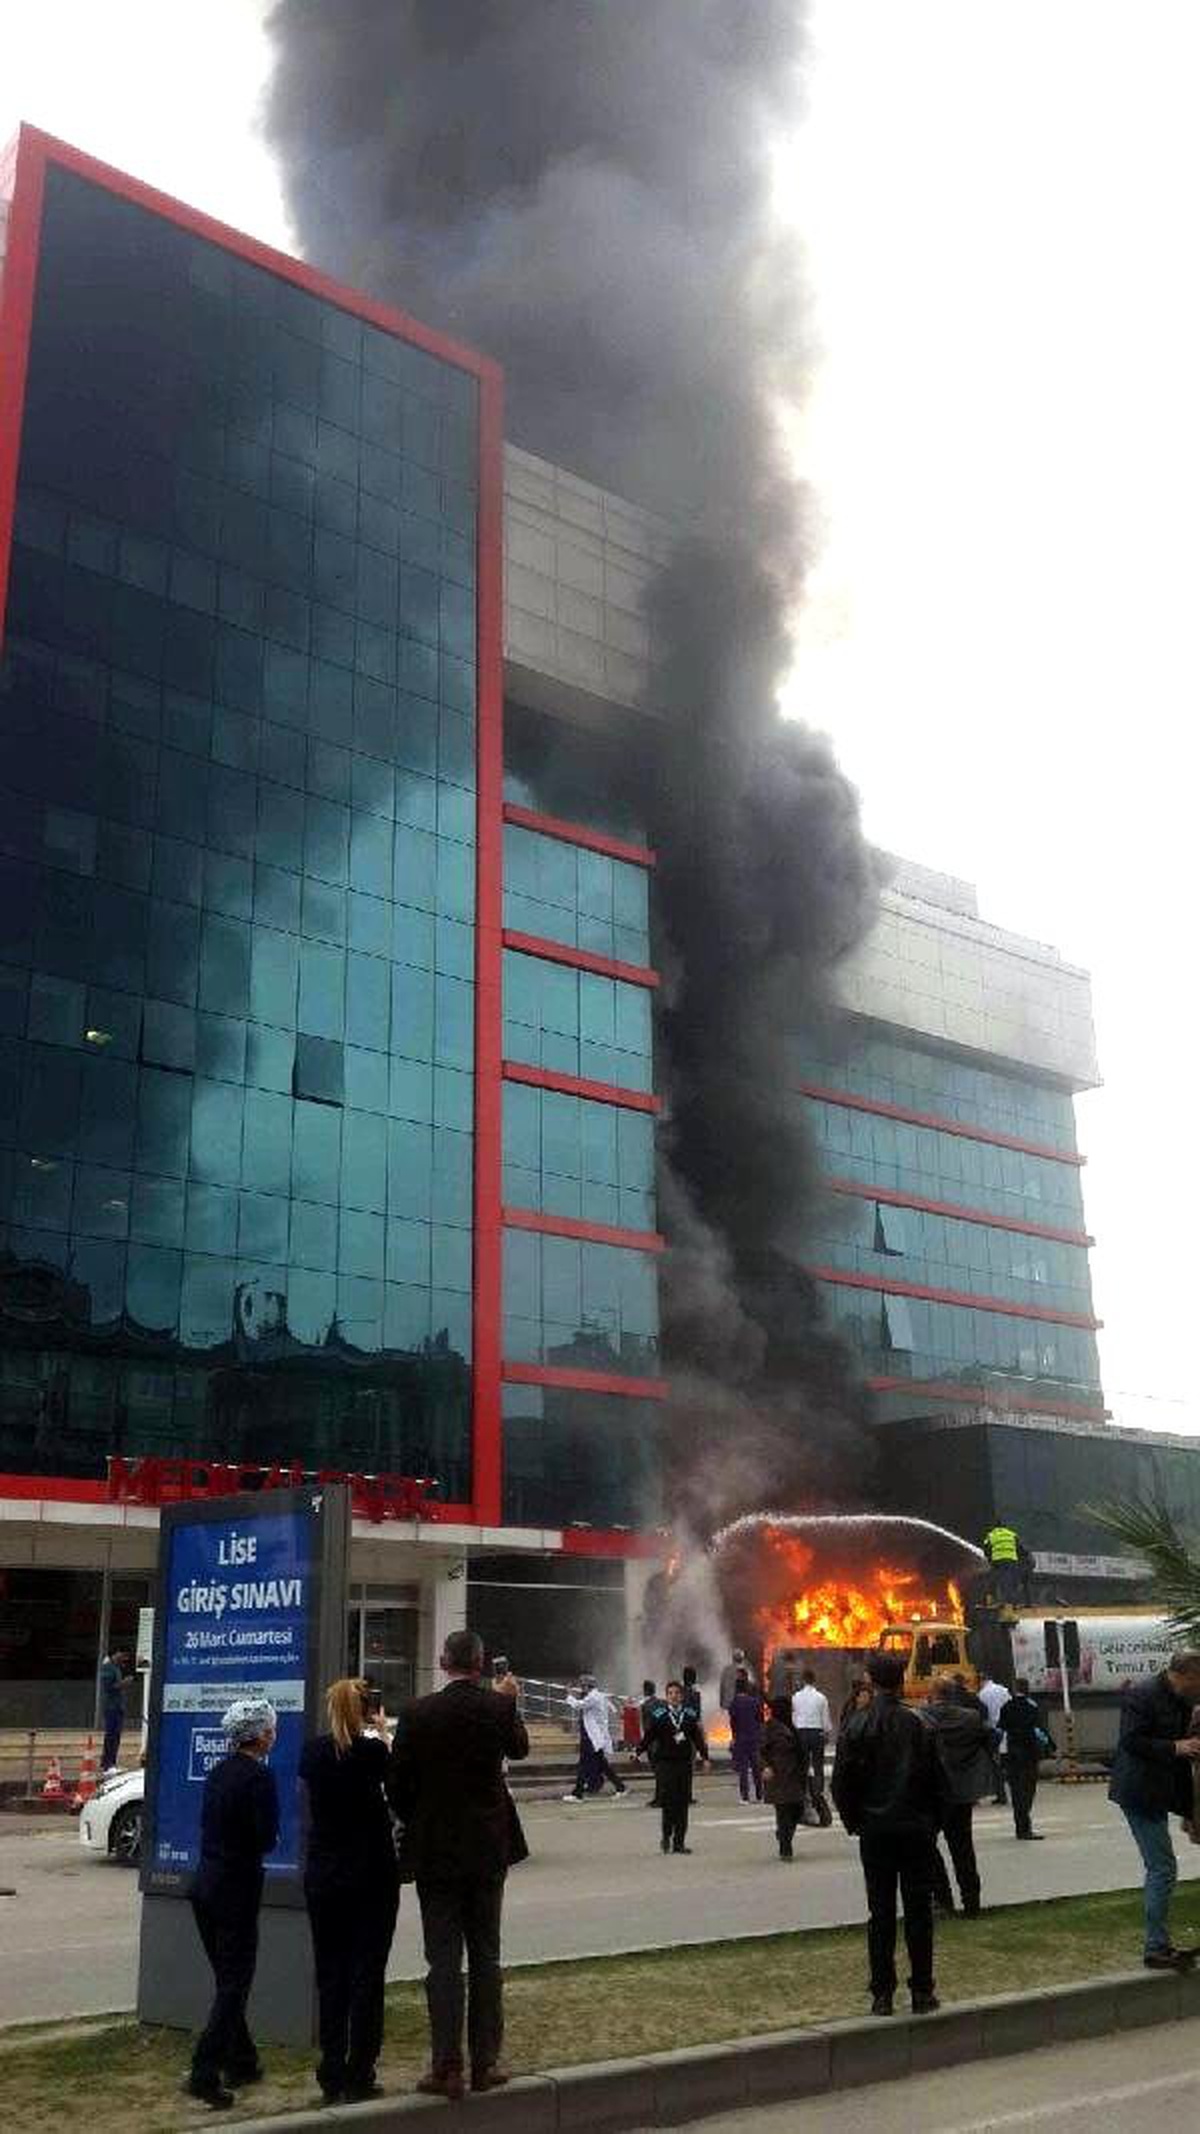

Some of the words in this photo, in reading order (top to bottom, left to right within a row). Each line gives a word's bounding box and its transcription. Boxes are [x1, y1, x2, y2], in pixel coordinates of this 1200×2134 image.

[218, 1531, 257, 1566] LİSE
[177, 1579, 228, 1620] GİRİŞ
[230, 1579, 302, 1610] SINAVI
[200, 1631, 227, 1647] Mart
[229, 1627, 293, 1646] Cumartesi
[195, 1735, 229, 1755] Başar
